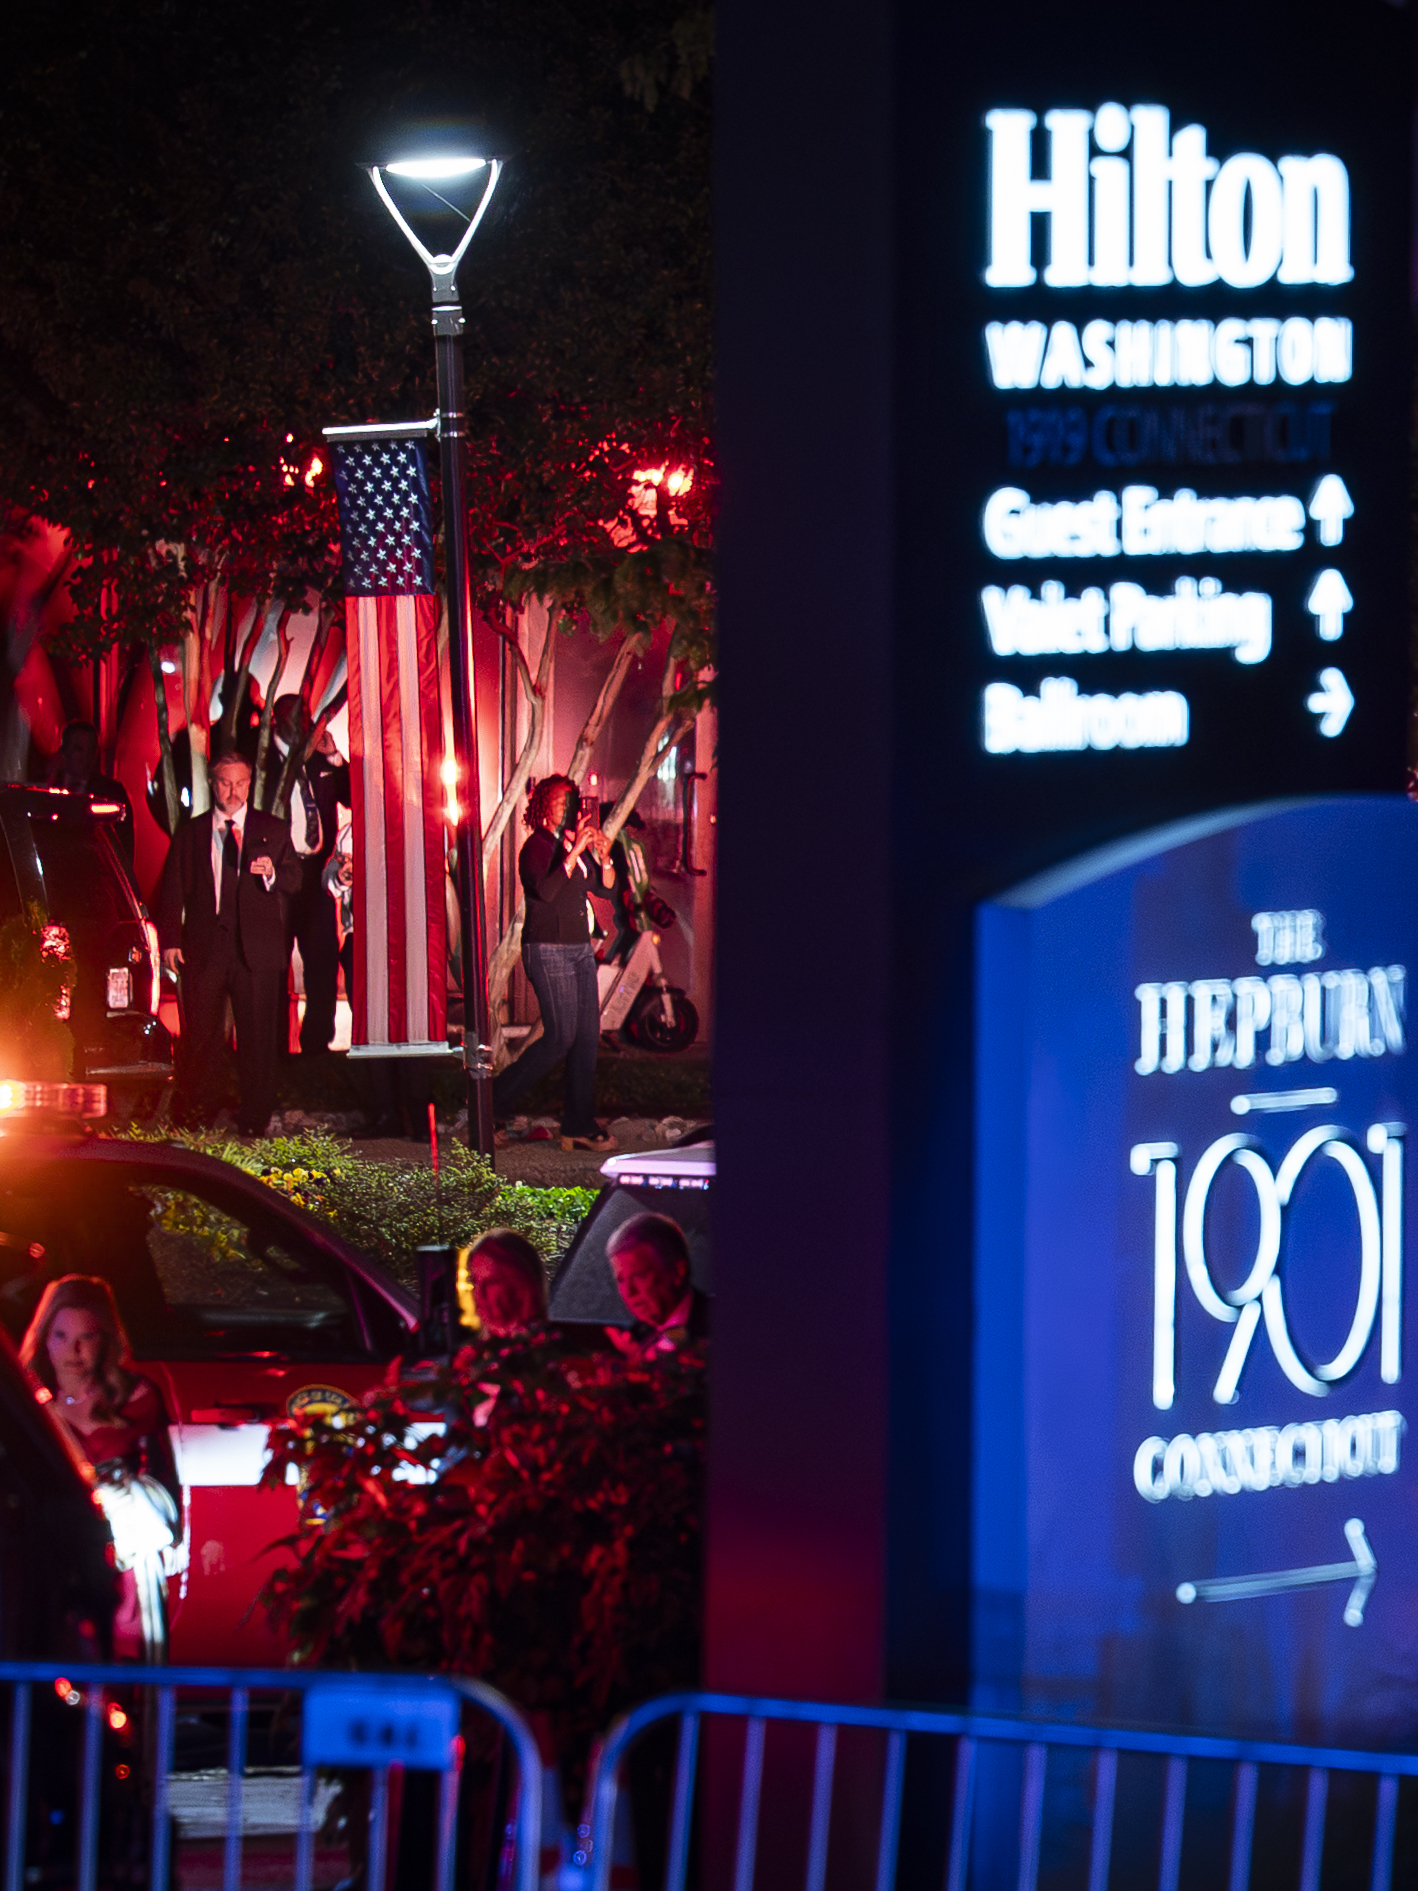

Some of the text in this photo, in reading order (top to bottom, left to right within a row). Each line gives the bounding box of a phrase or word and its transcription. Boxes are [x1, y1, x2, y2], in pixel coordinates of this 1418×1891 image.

[984, 101, 1354, 288] Hilton
[985, 317, 1353, 389] WASHINGTON
[984, 485, 1306, 560] Guest Entrance
[981, 576, 1272, 664] Valet Parking
[984, 677, 1189, 753] Ballroom
[1251, 909, 1325, 966] THE
[1134, 964, 1406, 1076] HEPBURN
[1130, 1121, 1407, 1410] 1901
